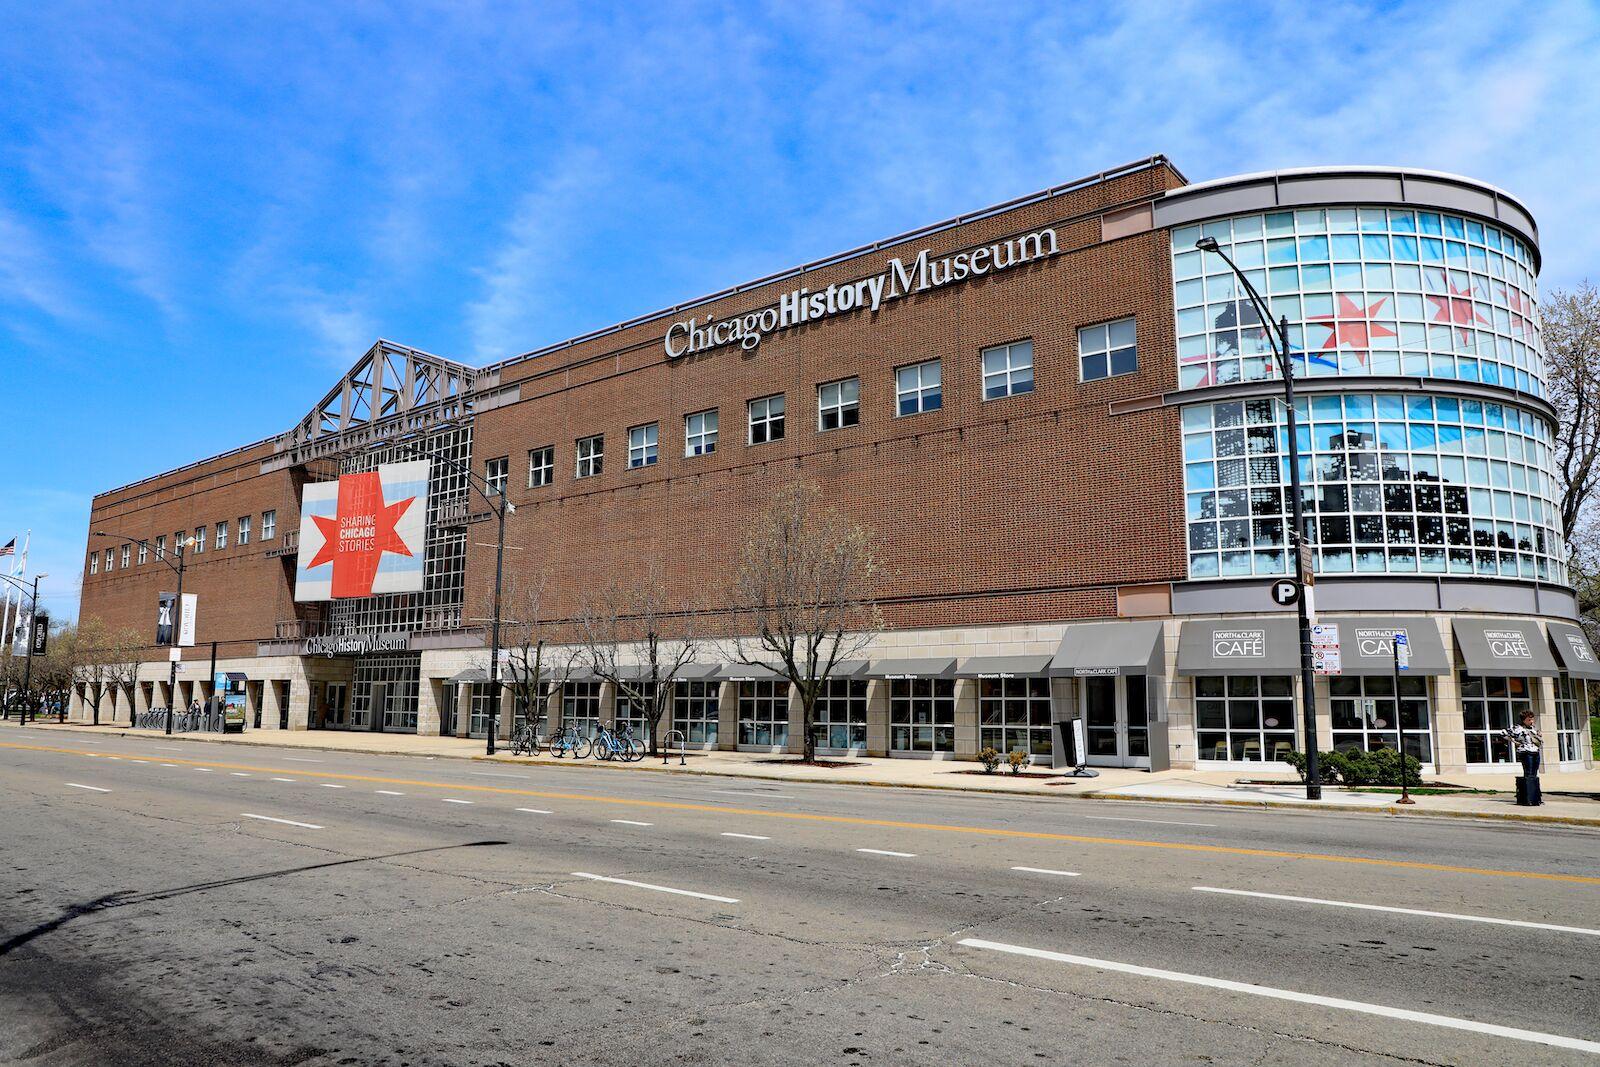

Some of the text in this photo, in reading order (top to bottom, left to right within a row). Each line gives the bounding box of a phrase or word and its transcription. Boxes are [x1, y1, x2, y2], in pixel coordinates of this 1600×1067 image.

[340, 514, 376, 528] SHARING
[340, 527, 376, 539] CHICAGO
[338, 538, 375, 552] STORIES
[1278, 583, 1296, 602] P
[1215, 638, 1263, 656] CAFÉ
[1491, 638, 1530, 656] CAFÉ
